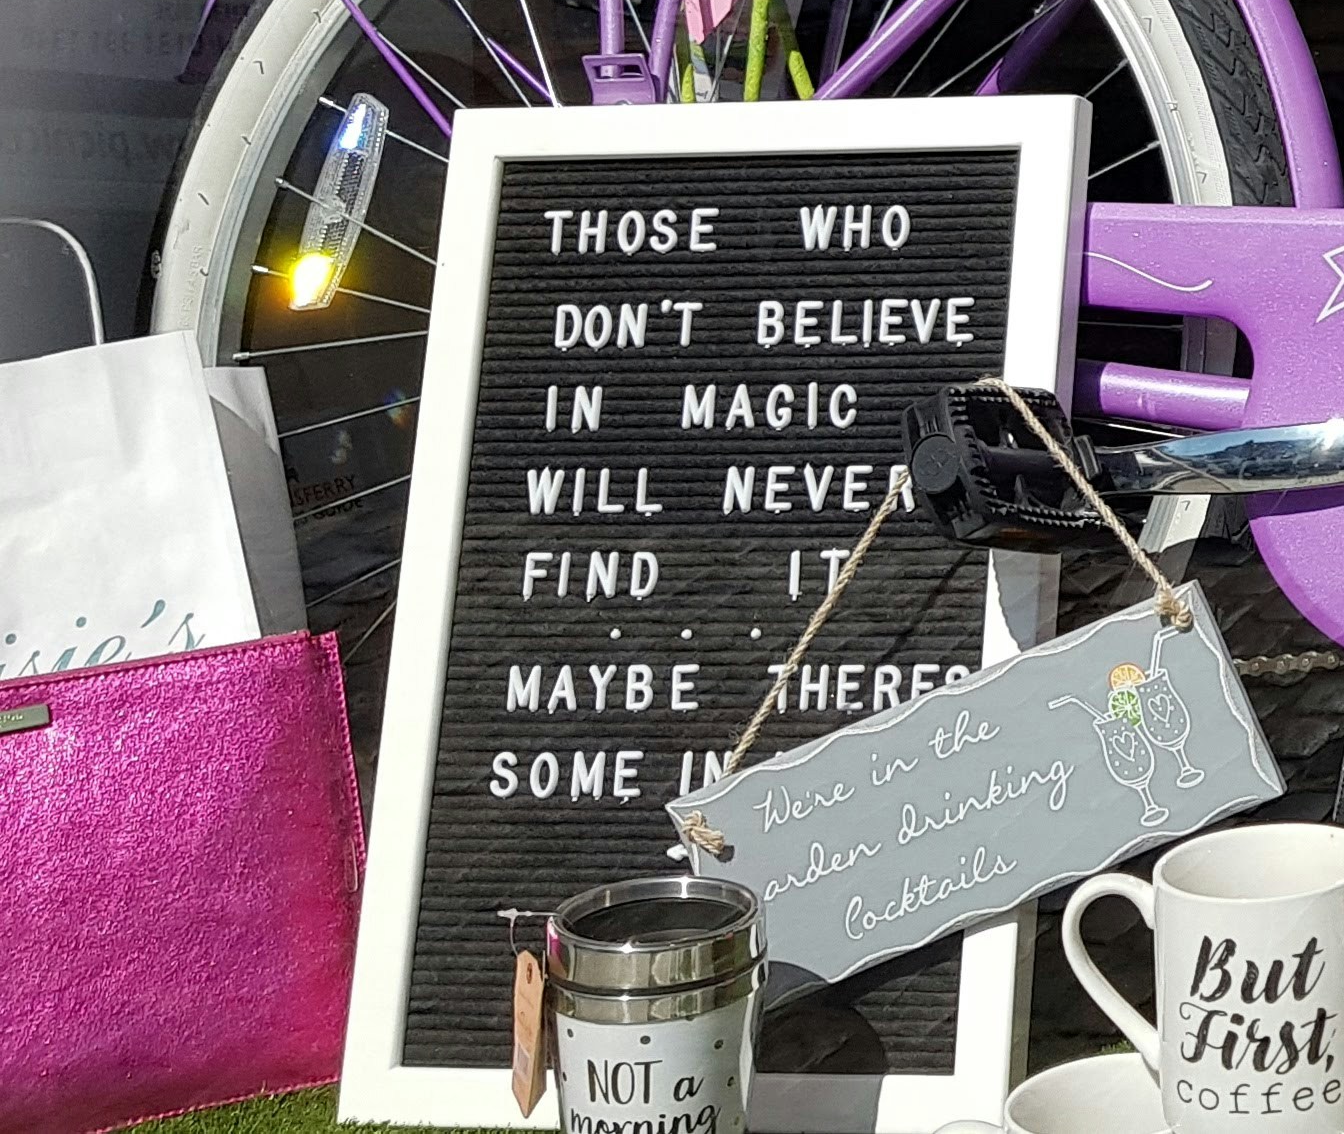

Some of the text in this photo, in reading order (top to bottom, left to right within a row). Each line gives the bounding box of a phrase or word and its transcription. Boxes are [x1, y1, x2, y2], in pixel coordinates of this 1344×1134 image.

[543, 203, 912, 257] THOSE WHO
[554, 296, 976, 352] DON'T BELIEVE
[545, 380, 859, 434] IN MAGIC
[526, 463, 917, 517] WILL NEVER
[521, 547, 853, 603] FIND IT
[505, 663, 701, 715] MAYBE
[489, 750, 645, 805] SOME
[752, 710, 1001, 832] We're in the
[762, 759, 1076, 901] arden drinking
[843, 845, 1018, 941] Cocktails
[1189, 935, 1327, 1006] But
[1177, 999, 1341, 1074] First,
[587, 1059, 704, 1104] NOT a
[1176, 1076, 1343, 1115] coffee
